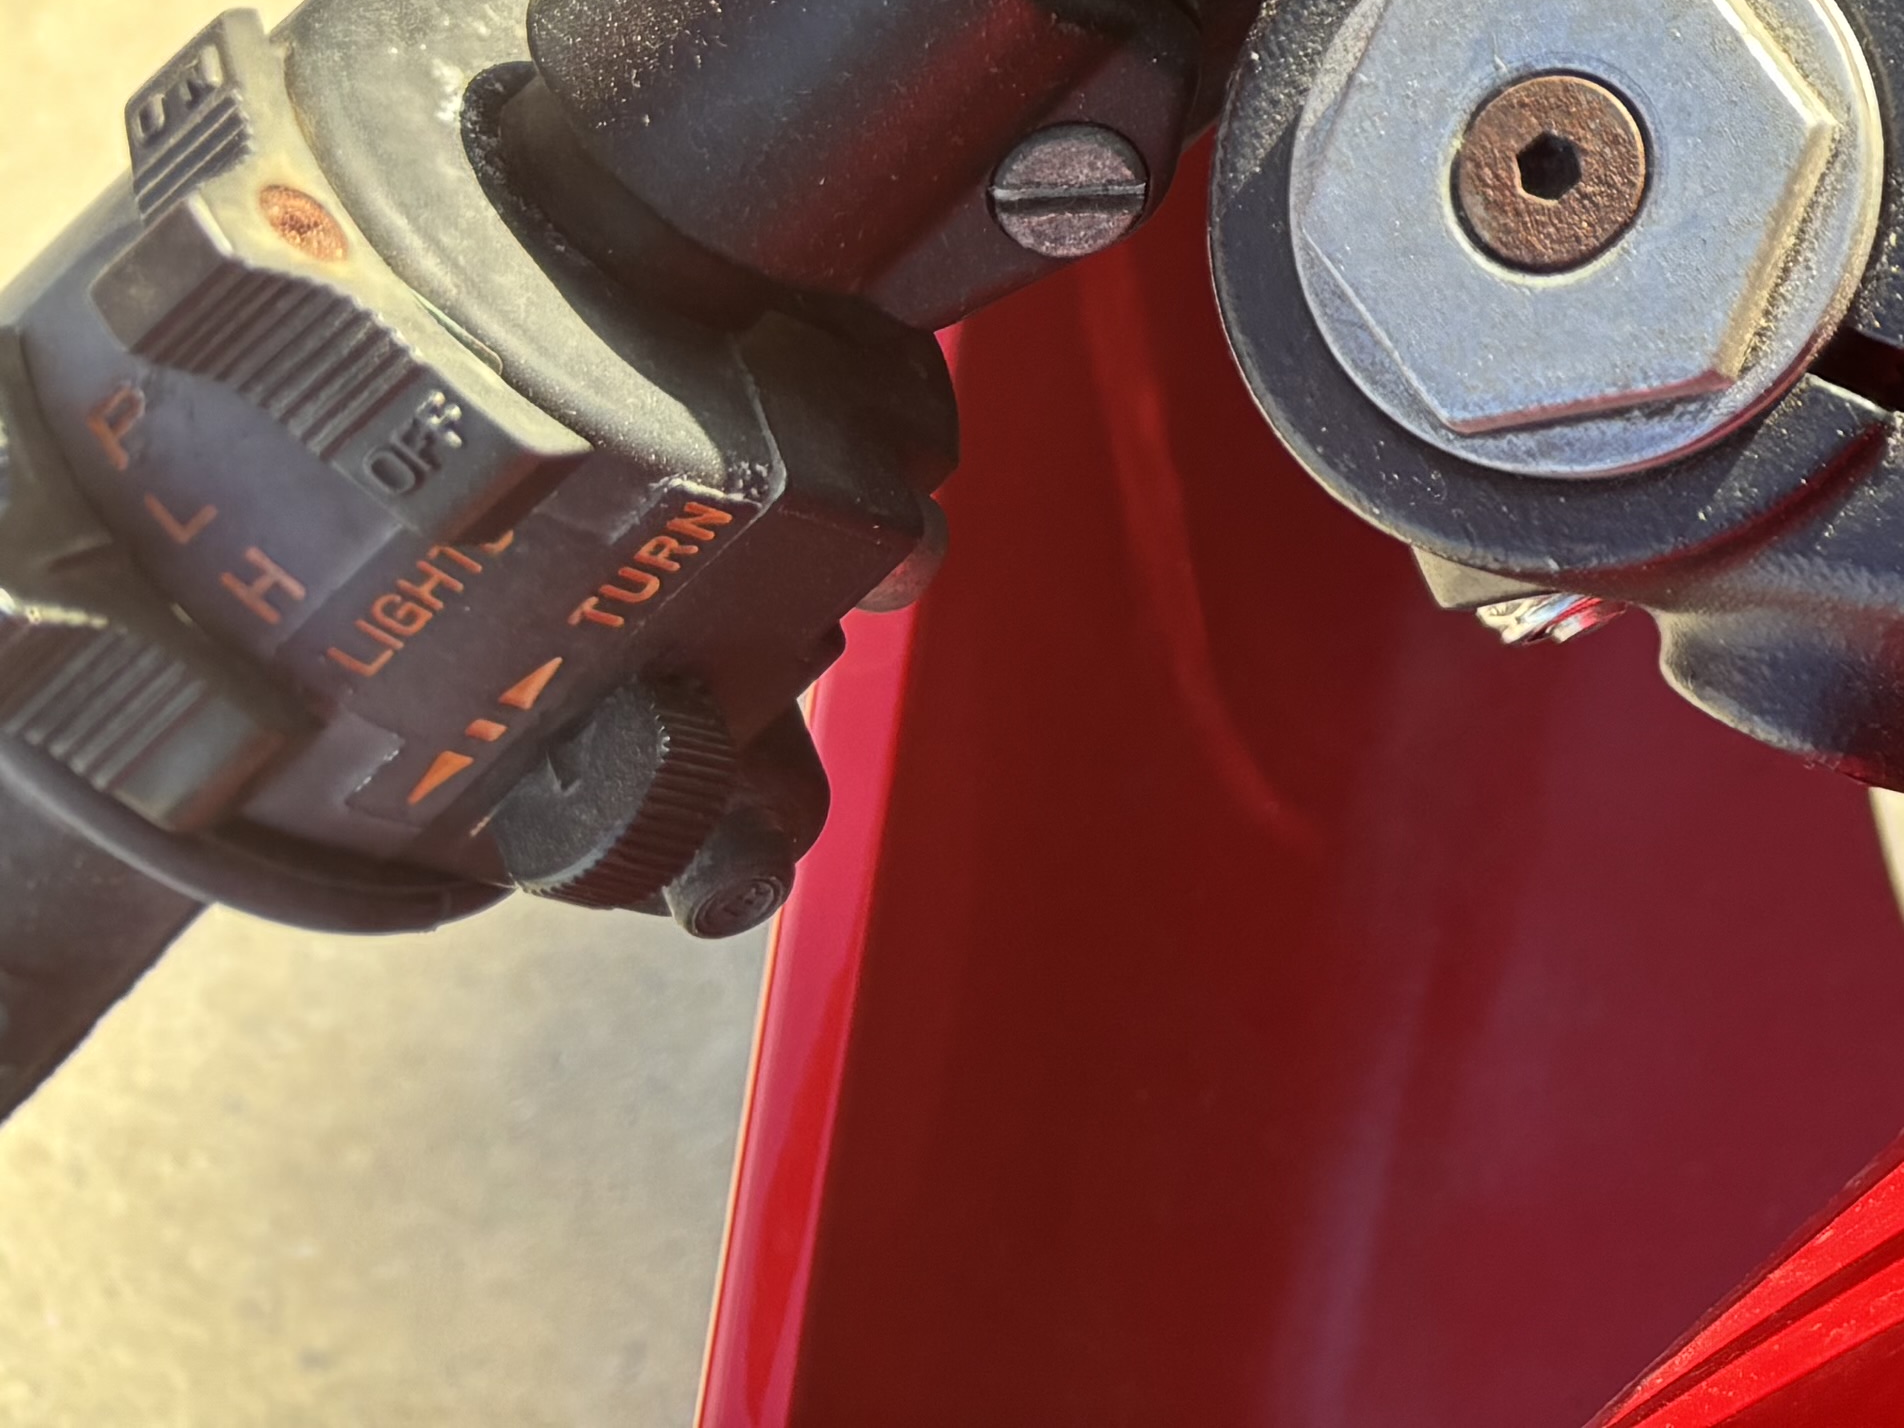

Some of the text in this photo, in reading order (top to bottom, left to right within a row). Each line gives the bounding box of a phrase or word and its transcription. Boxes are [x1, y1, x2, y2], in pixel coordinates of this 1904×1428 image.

[87, 384, 147, 472] P
[363, 389, 464, 495] OFF
[144, 493, 220, 545] L
[219, 545, 306, 625] H
[567, 500, 734, 629] TURN
